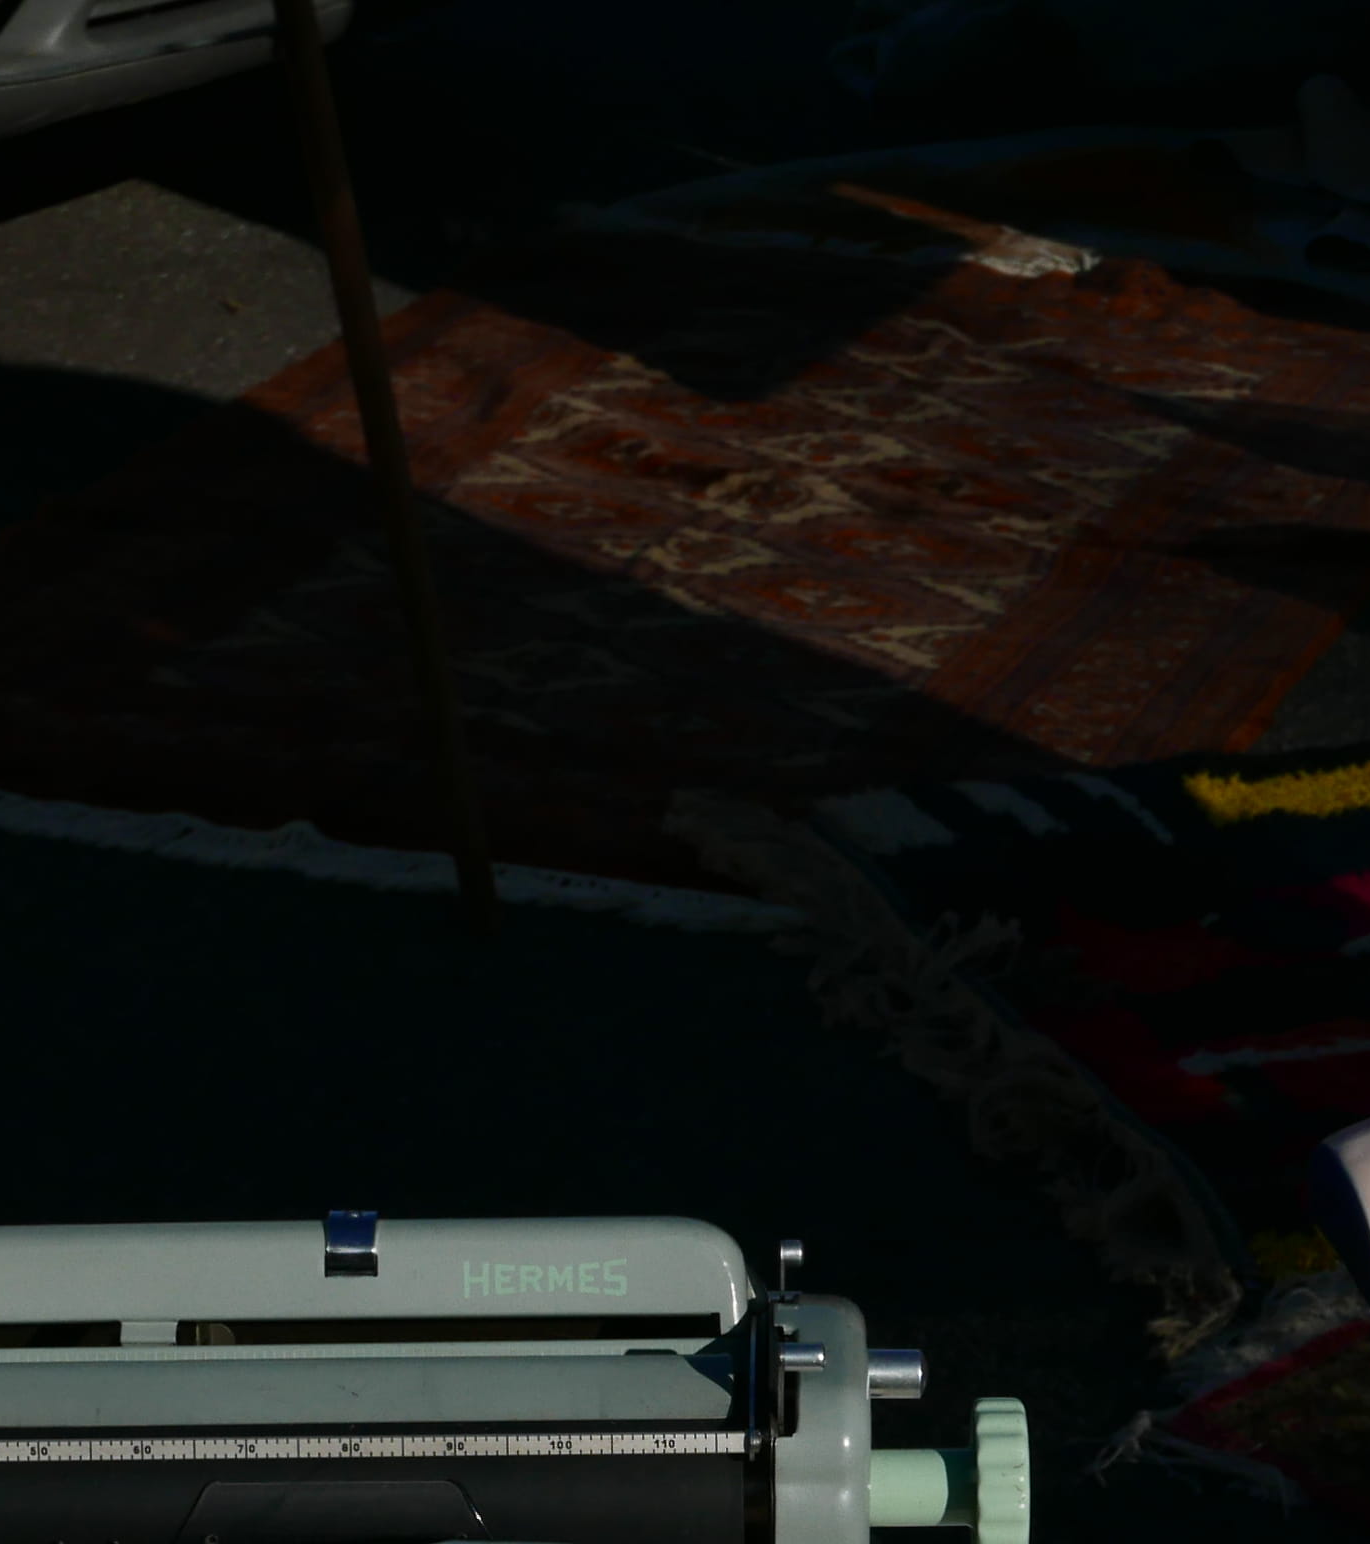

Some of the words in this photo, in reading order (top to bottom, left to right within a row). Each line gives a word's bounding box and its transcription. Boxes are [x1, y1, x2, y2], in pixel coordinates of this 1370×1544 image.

[462, 1258, 628, 1299] HERMES
[30, 1447, 49, 1457] 50
[133, 1445, 152, 1456] 60
[237, 1444, 256, 1454] 70
[341, 1442, 361, 1453] 80
[445, 1441, 465, 1452] 90
[549, 1440, 573, 1451] 100
[653, 1438, 676, 1449] 110
